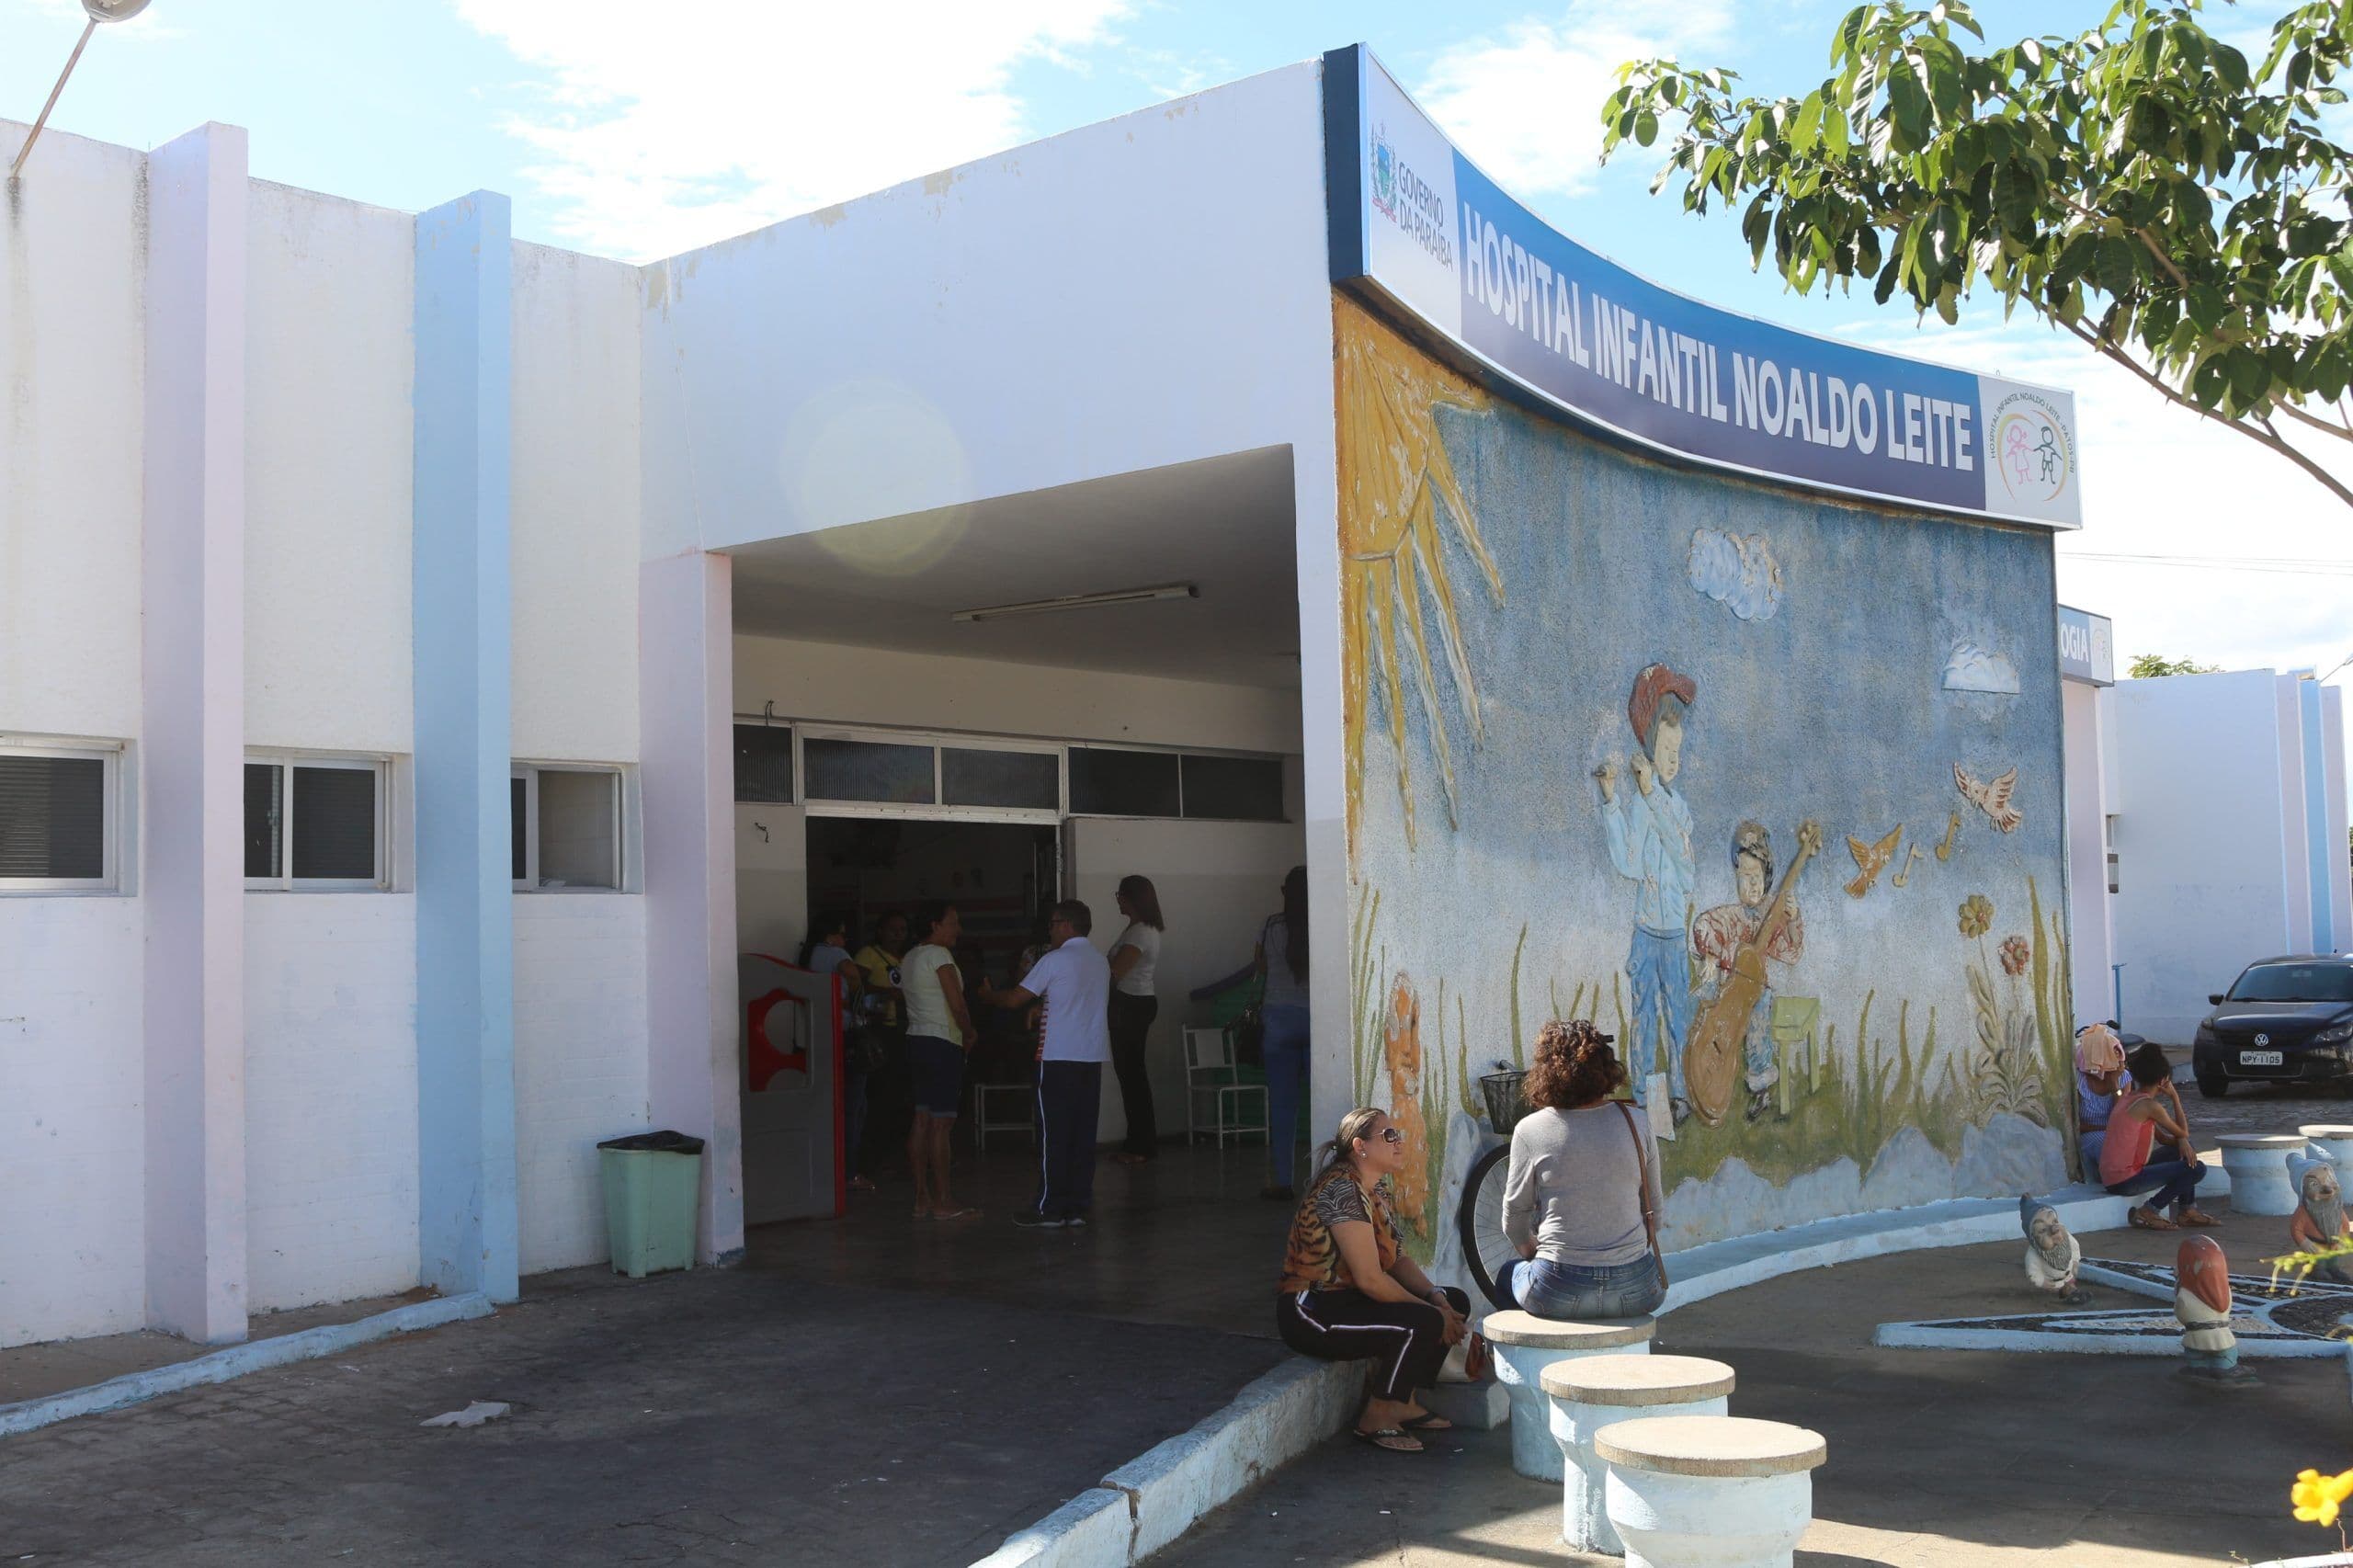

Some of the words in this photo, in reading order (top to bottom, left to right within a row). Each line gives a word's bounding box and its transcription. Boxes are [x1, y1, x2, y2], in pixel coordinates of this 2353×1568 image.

[1398, 161, 1444, 224] GOVERNO
[1400, 198, 1414, 239] DA
[1415, 211, 1453, 272] PARAÍBA
[1464, 201, 1589, 369] HOSPITAL
[1592, 292, 1727, 423] INFANTIL
[1733, 352, 1878, 455] NOALDO
[1885, 389, 1973, 472] LEITE
[1989, 414, 2000, 459] HOSPITAL
[2019, 392, 2045, 406] NOALDO
